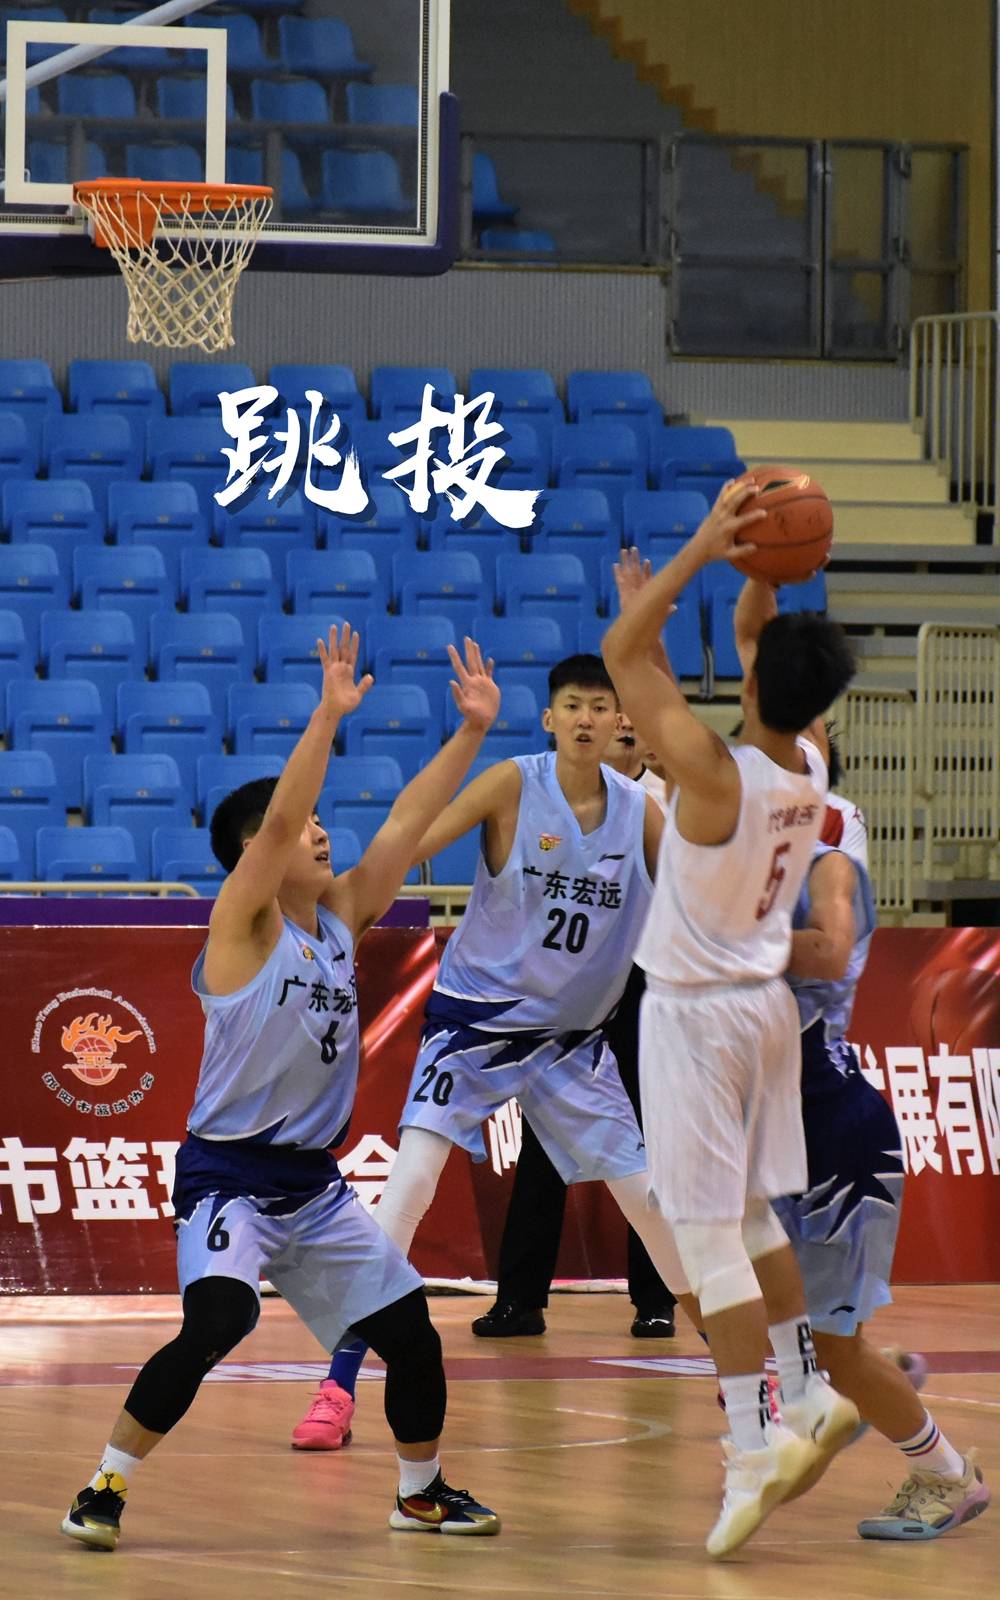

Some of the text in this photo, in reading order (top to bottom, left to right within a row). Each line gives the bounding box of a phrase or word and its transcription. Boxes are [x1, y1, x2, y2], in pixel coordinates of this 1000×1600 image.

[523, 866, 622, 910] 广东宏远
[755, 842, 791, 922] 5
[542, 907, 590, 954] 20
[320, 1020, 338, 1064] 6
[412, 1064, 454, 1107] 20
[206, 1216, 230, 1252] 6
